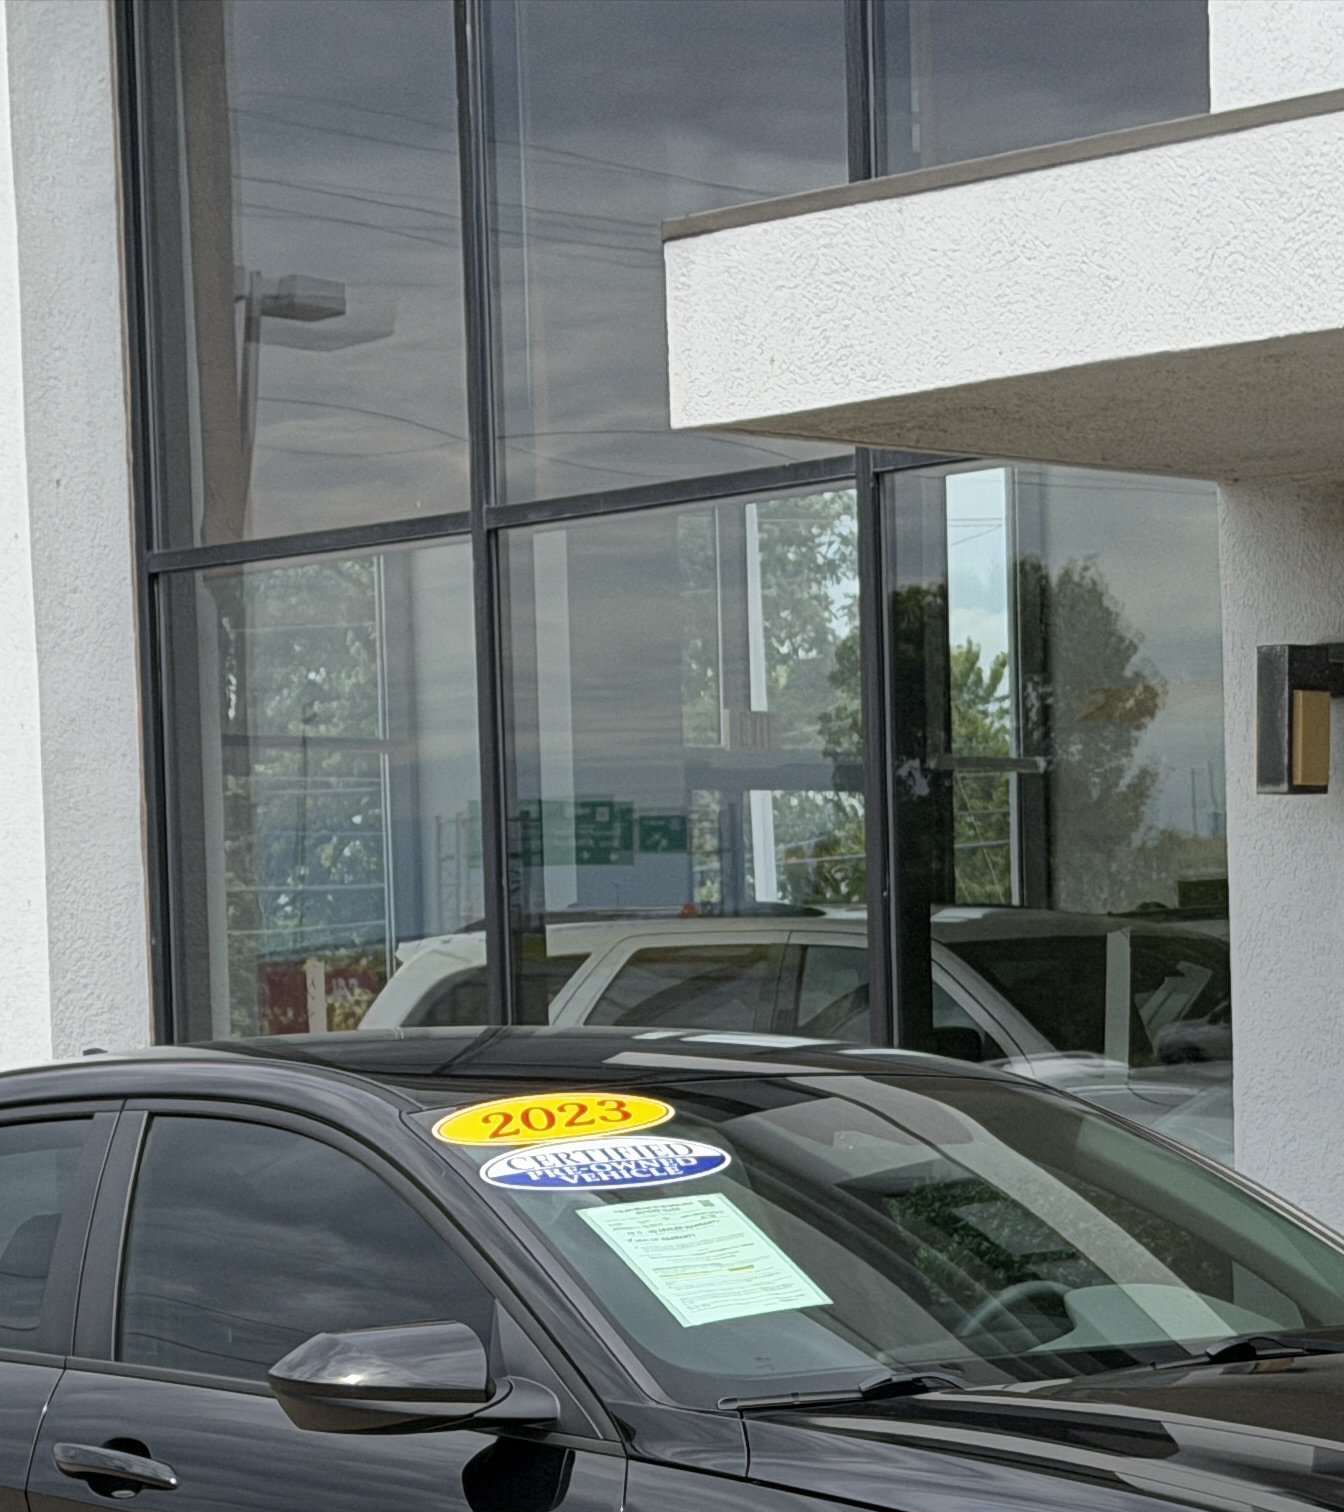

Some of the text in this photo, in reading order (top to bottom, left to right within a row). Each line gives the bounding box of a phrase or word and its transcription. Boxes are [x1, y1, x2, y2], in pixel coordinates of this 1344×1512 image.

[481, 1100, 632, 1139] 2023
[506, 1142, 694, 1171] CERTIFIED
[528, 1157, 698, 1181] PRE-OWNED
[555, 1164, 684, 1184] VEHICLE
